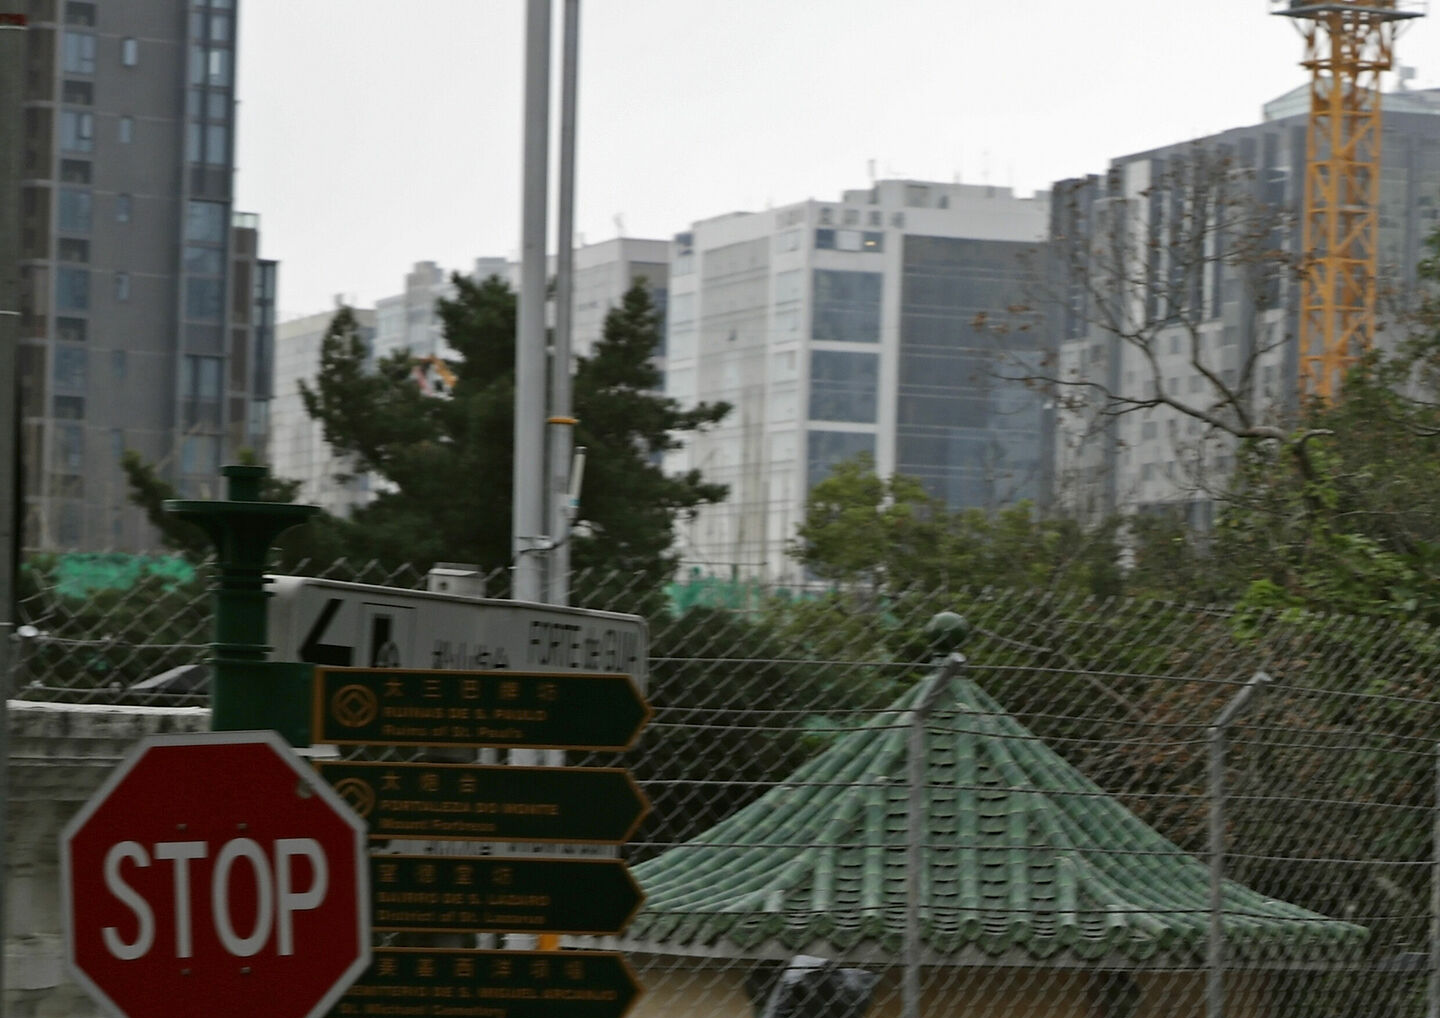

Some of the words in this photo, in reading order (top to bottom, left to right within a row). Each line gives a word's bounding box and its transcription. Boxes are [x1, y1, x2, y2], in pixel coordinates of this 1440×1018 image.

[448, 707, 469, 719] DE
[493, 709, 547, 721] PAULO
[382, 724, 429, 736] Ruins
[431, 725, 450, 737] of
[503, 802, 560, 816] MONTE
[378, 817, 430, 830] Mount
[102, 837, 329, 960] STOP
[376, 891, 438, 904] BAIRRO
[443, 893, 464, 905] DE
[440, 910, 457, 922] of
[433, 985, 454, 999] DE
[479, 986, 538, 1000] MIGUEL
